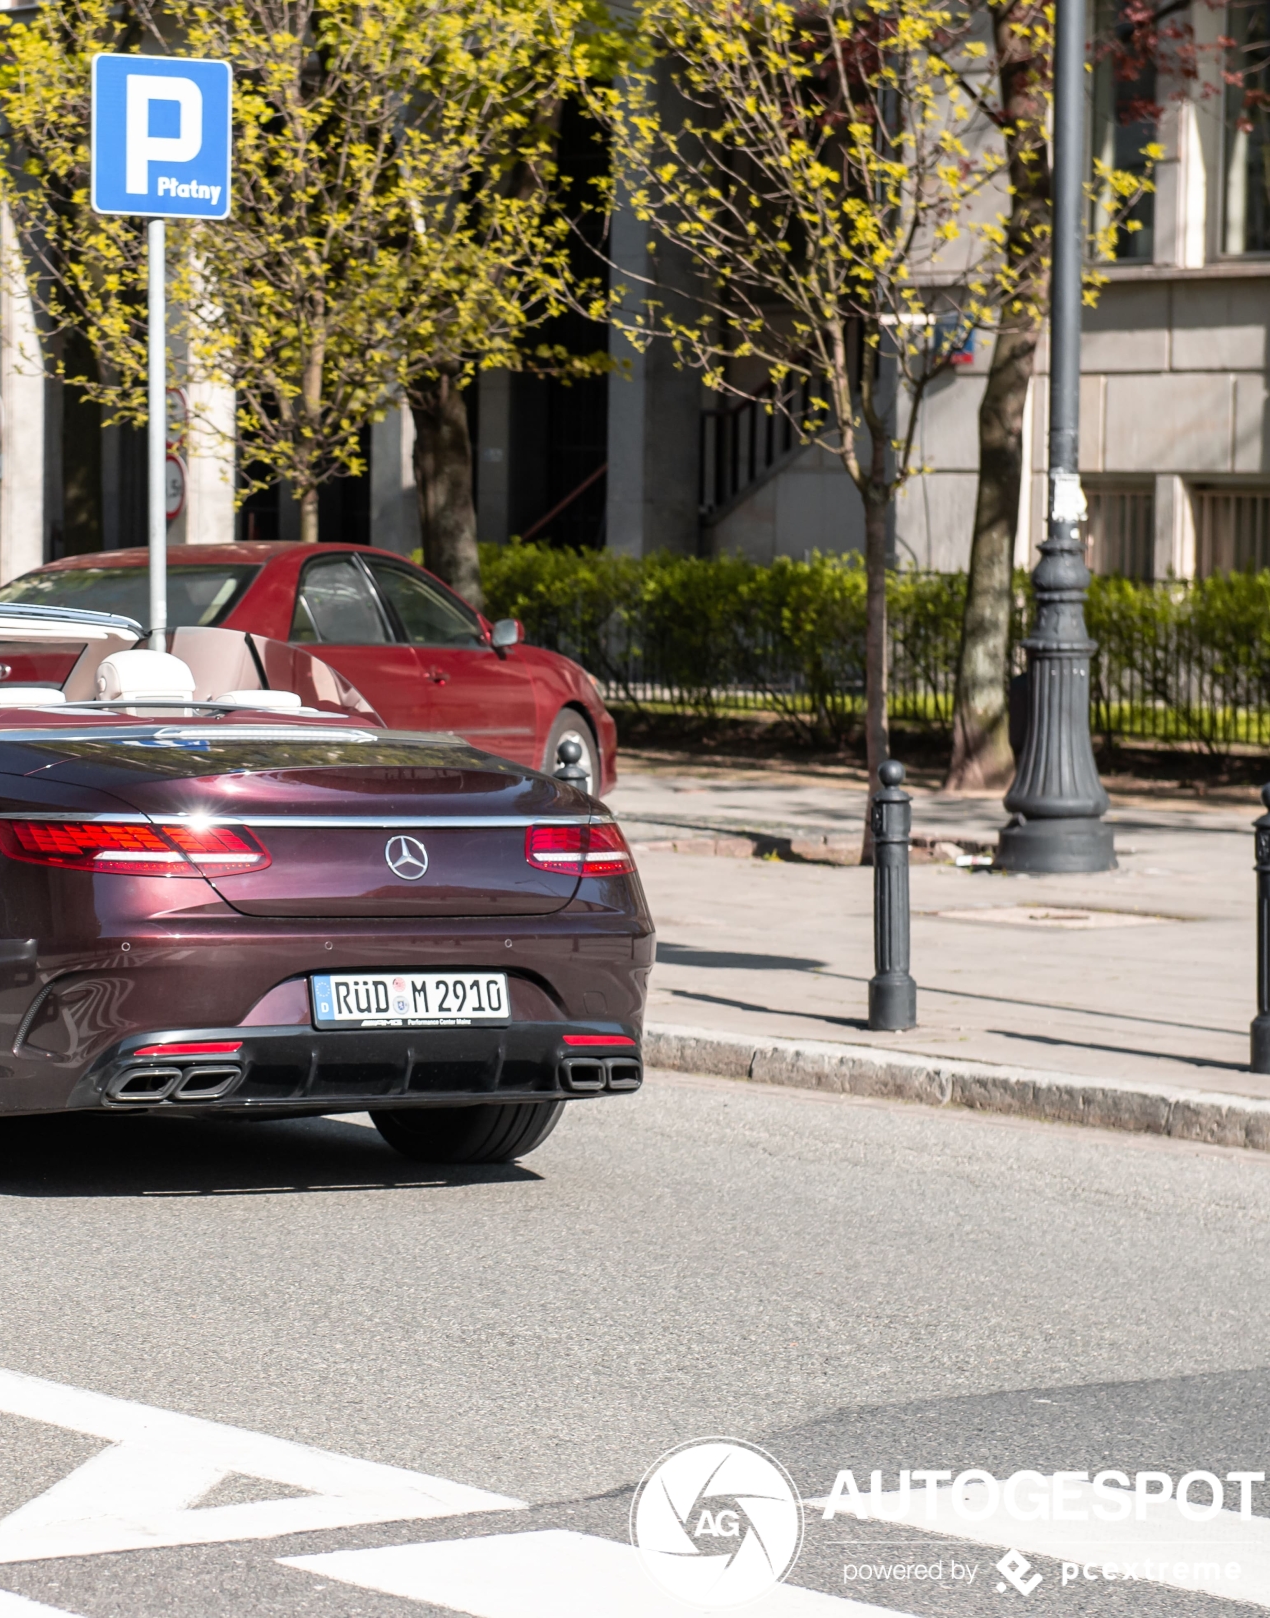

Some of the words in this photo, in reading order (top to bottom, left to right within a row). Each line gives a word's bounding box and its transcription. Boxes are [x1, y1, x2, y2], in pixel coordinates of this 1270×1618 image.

[126, 74, 203, 194] P
[157, 176, 221, 206] Płatny
[321, 1002, 330, 1013] D
[411, 980, 430, 1013] M
[434, 979, 502, 1013] 2910
[407, 1018, 439, 1026] Performance
[439, 1018, 456, 1026] Center
